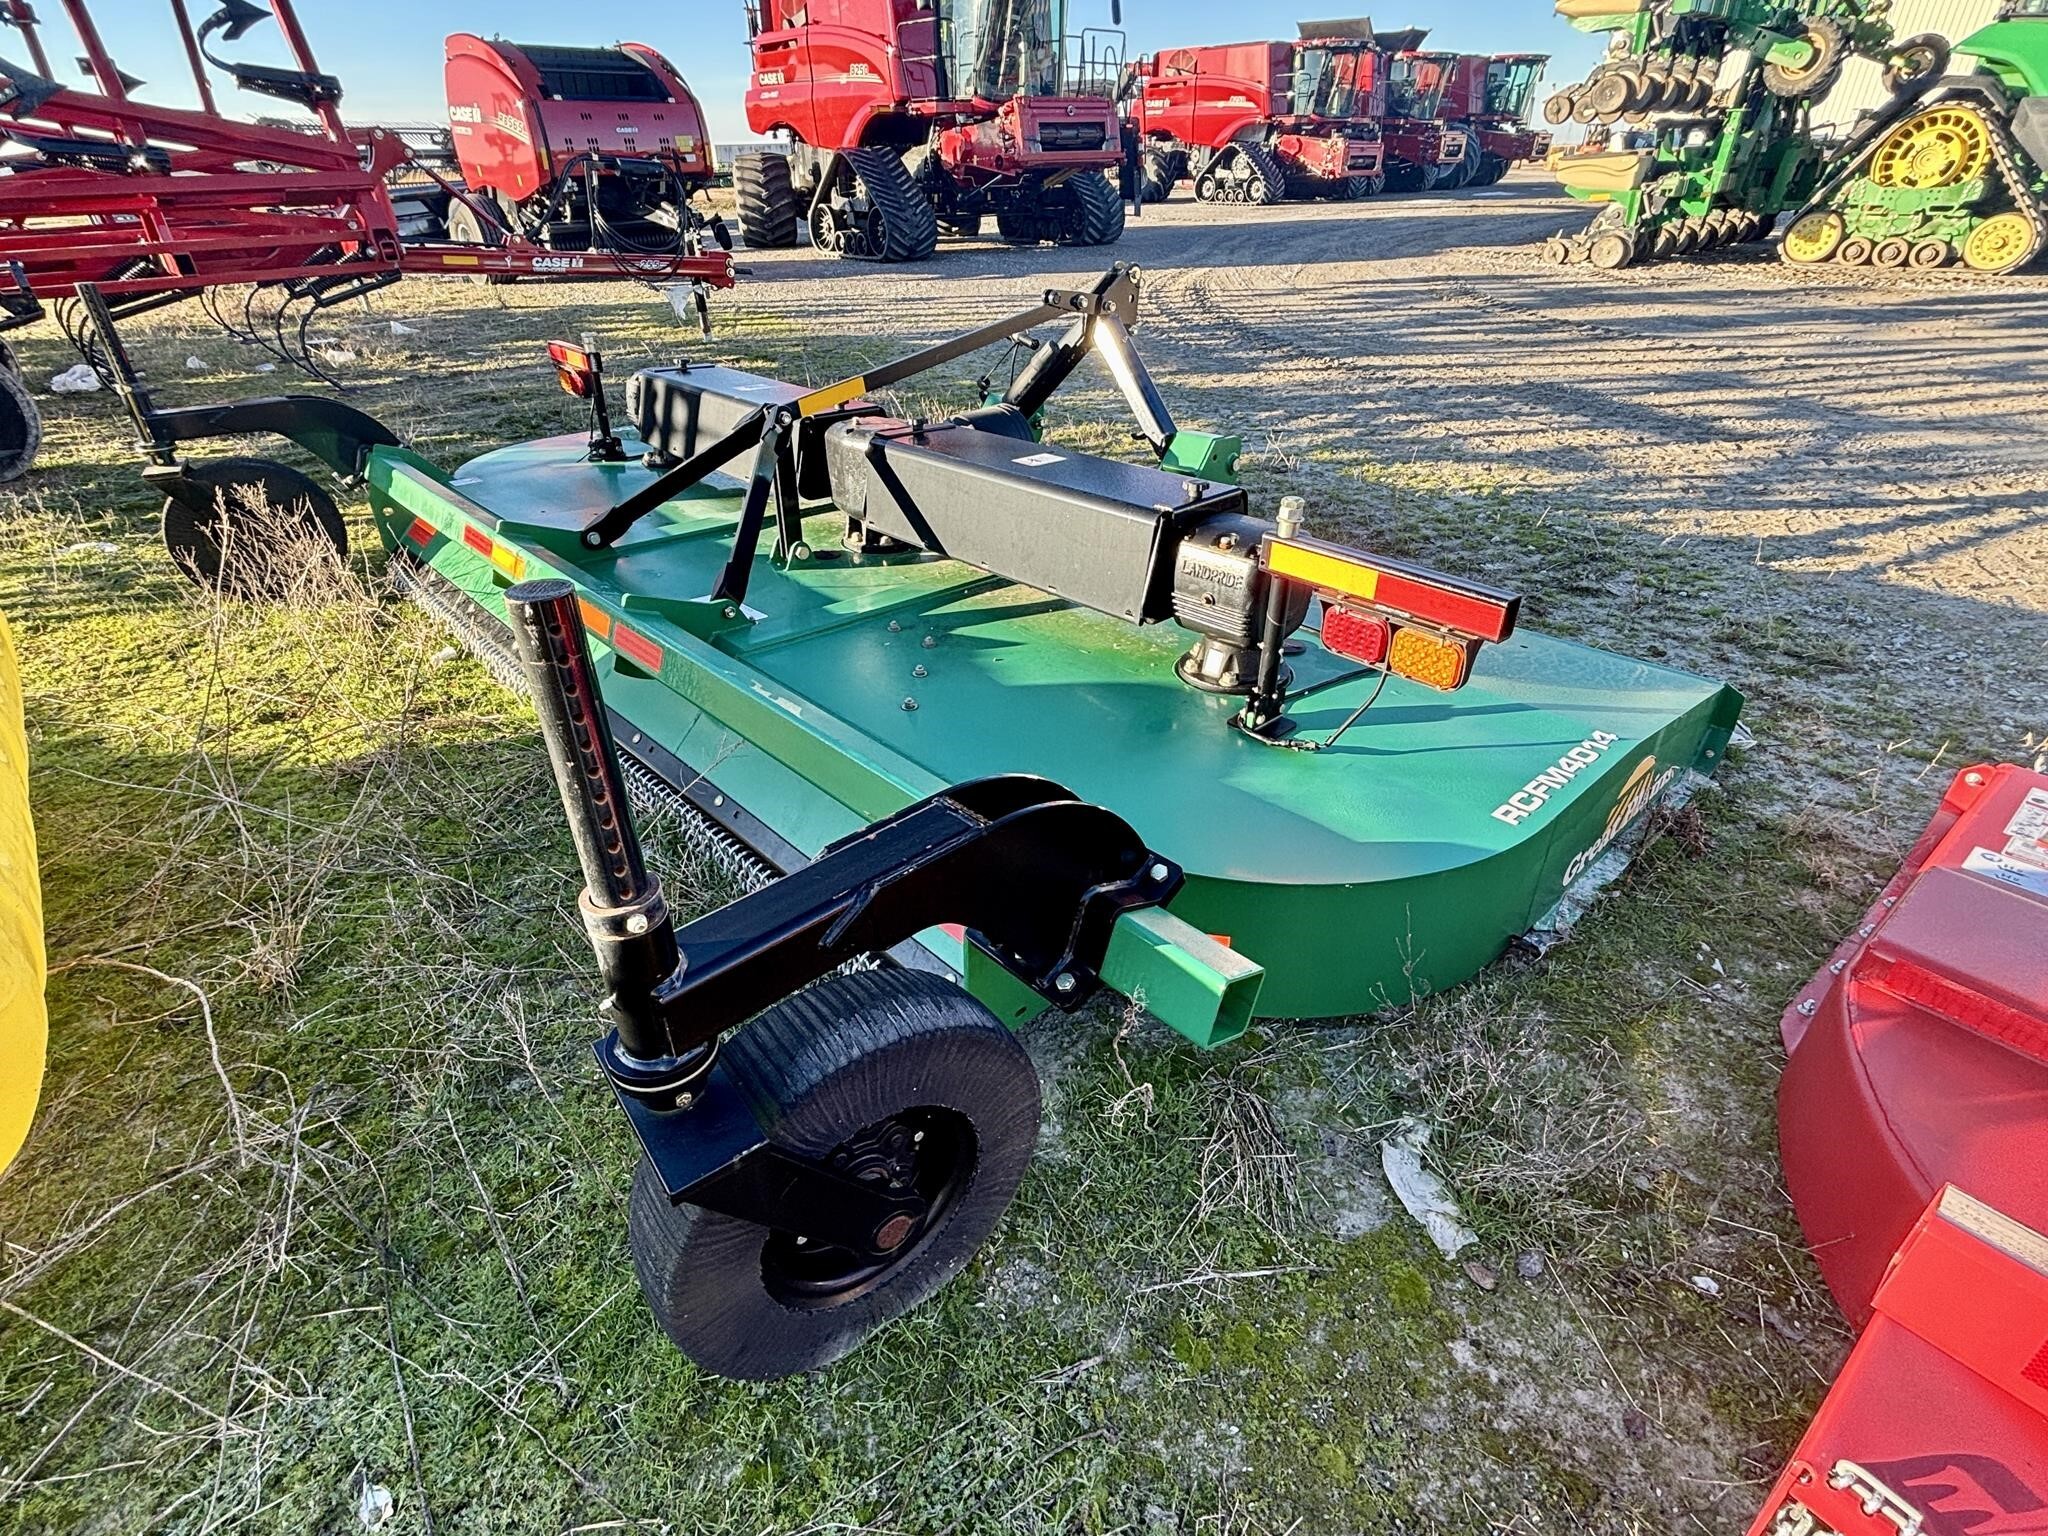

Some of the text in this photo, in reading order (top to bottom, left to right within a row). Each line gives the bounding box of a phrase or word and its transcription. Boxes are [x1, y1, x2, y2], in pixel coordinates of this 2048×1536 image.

[759, 72, 778, 86] CASE
[1145, 99, 1163, 108] CASE
[449, 106, 473, 123] CASE
[532, 257, 570, 268] CASE
[1490, 729, 1620, 827] RCFM4014
[1562, 815, 1622, 887] Great
